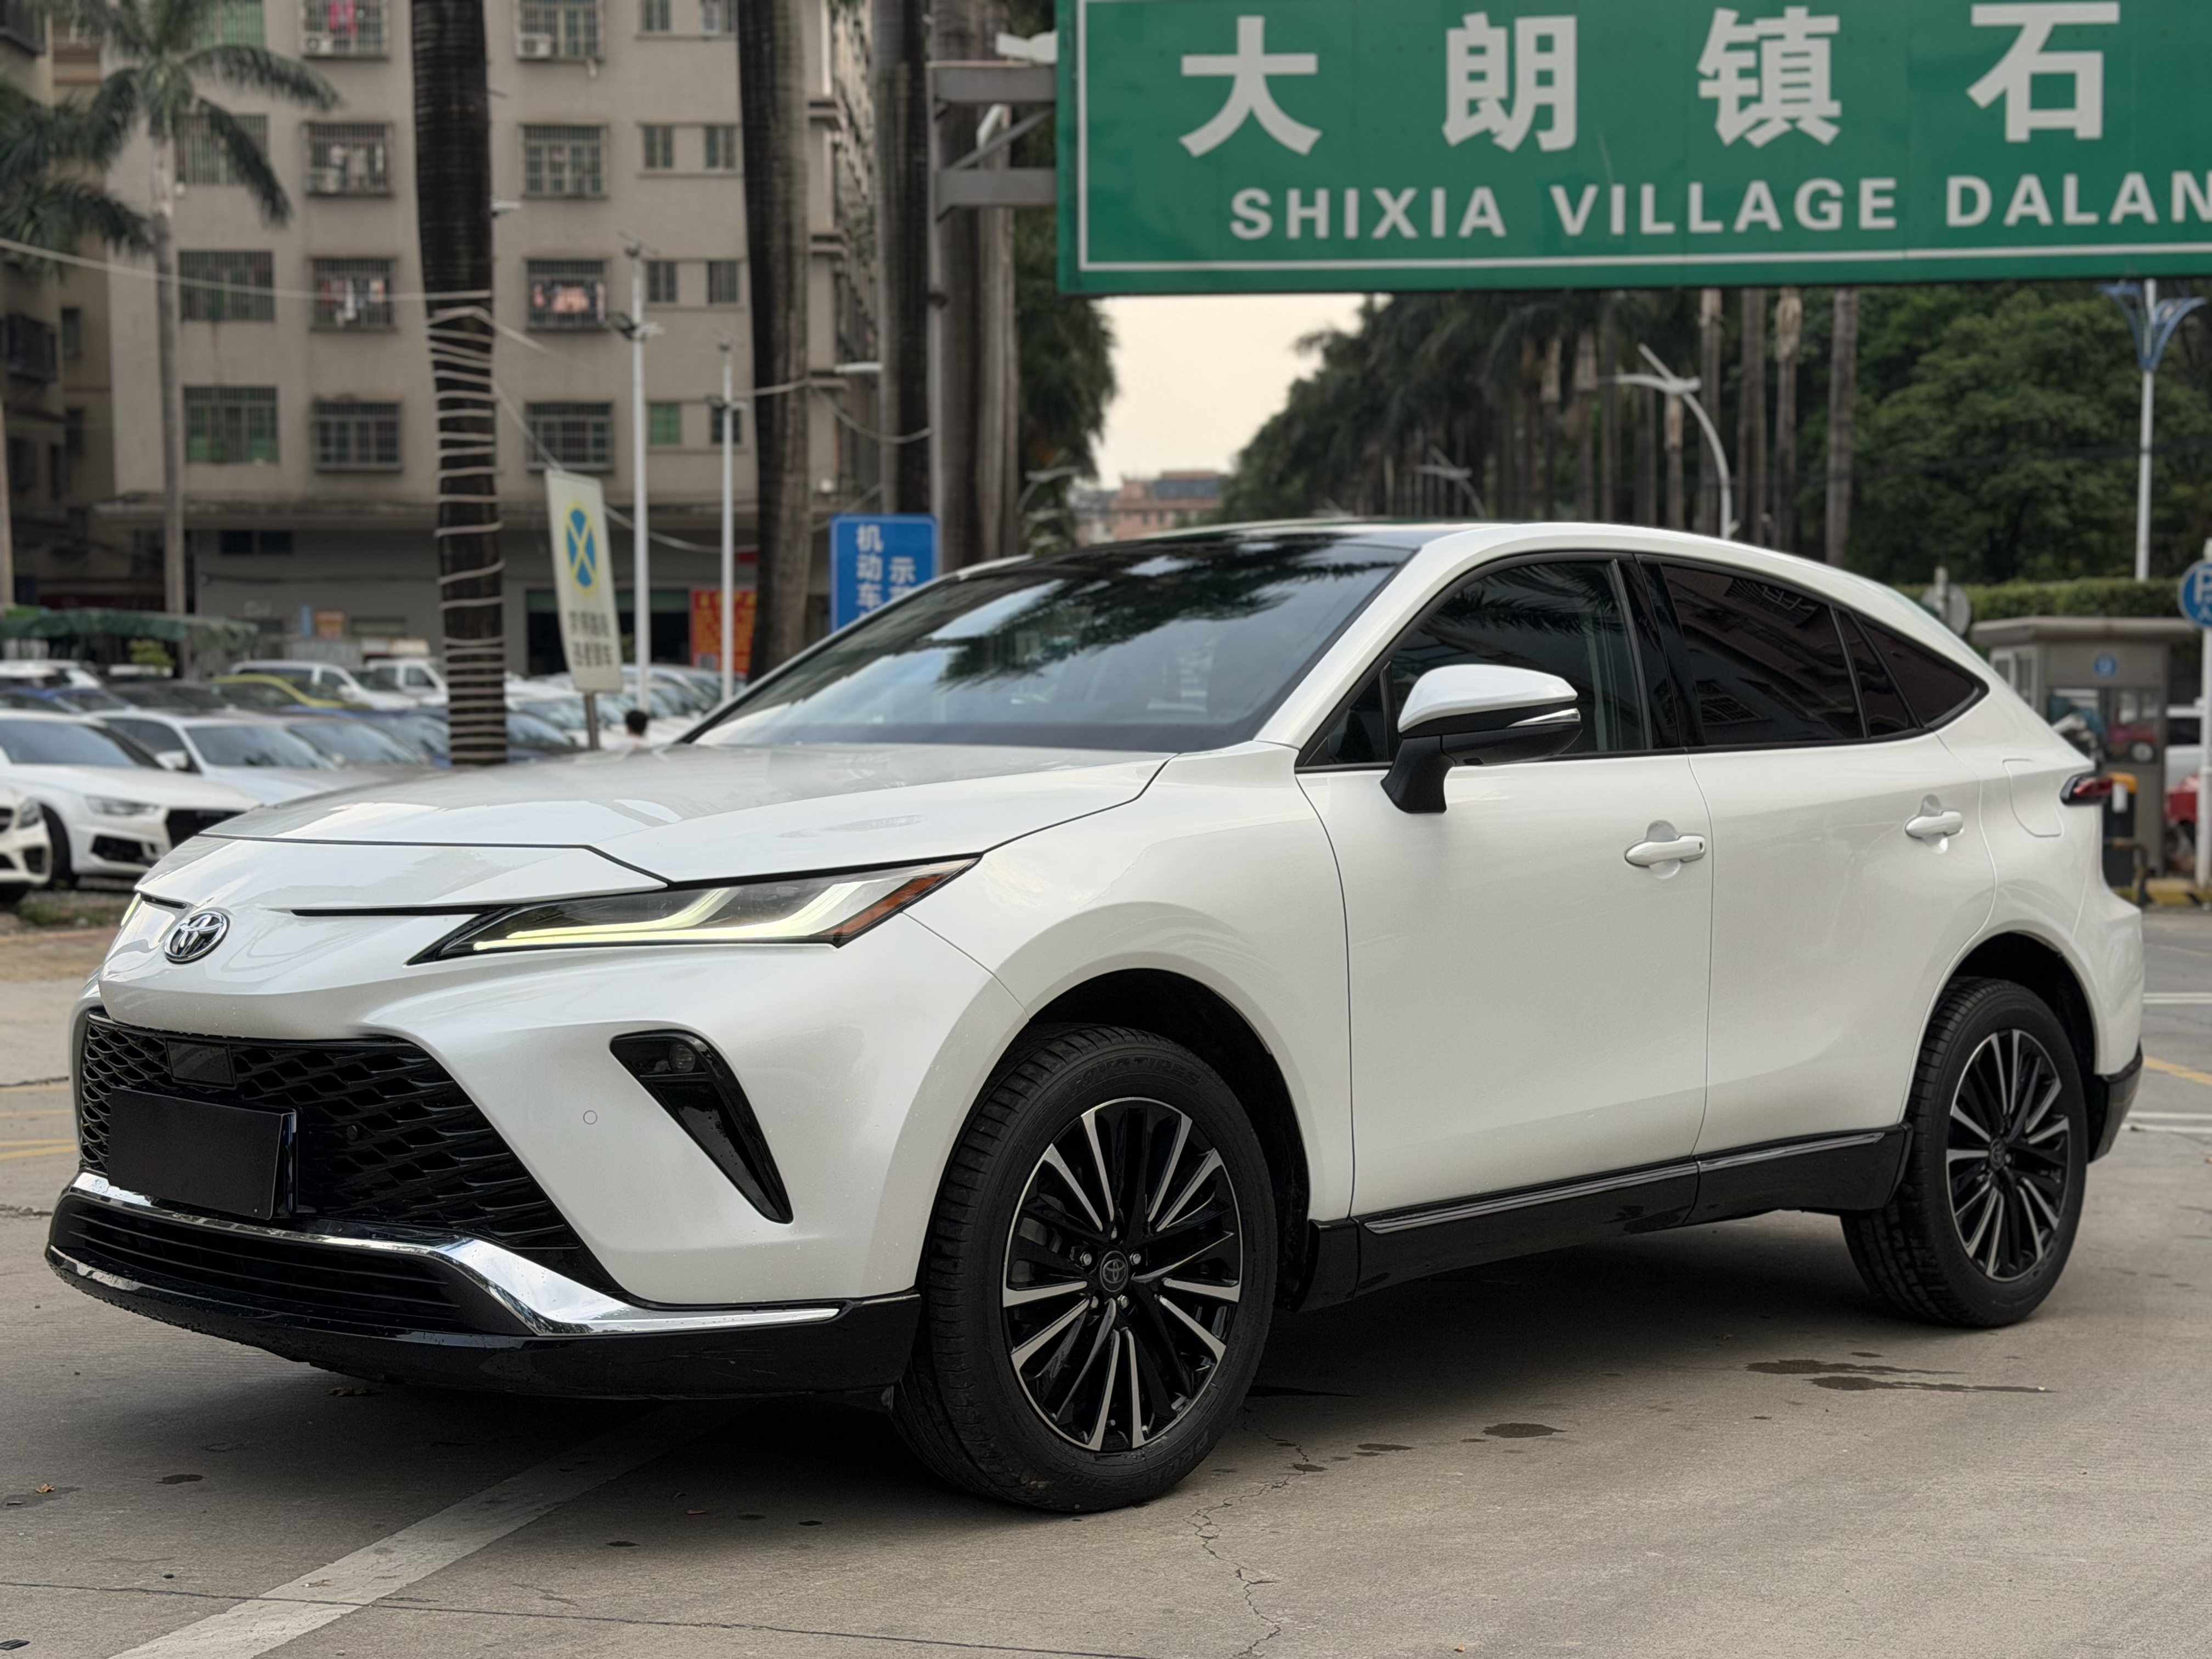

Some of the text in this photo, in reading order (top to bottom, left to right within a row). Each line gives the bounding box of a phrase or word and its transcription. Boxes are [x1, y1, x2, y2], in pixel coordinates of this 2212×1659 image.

[1178, 2, 2120, 158] 大朗镇石
[1230, 170, 2212, 240] SHIXIA VILLAGE DALAN
[856, 524, 884, 619] 机动车
